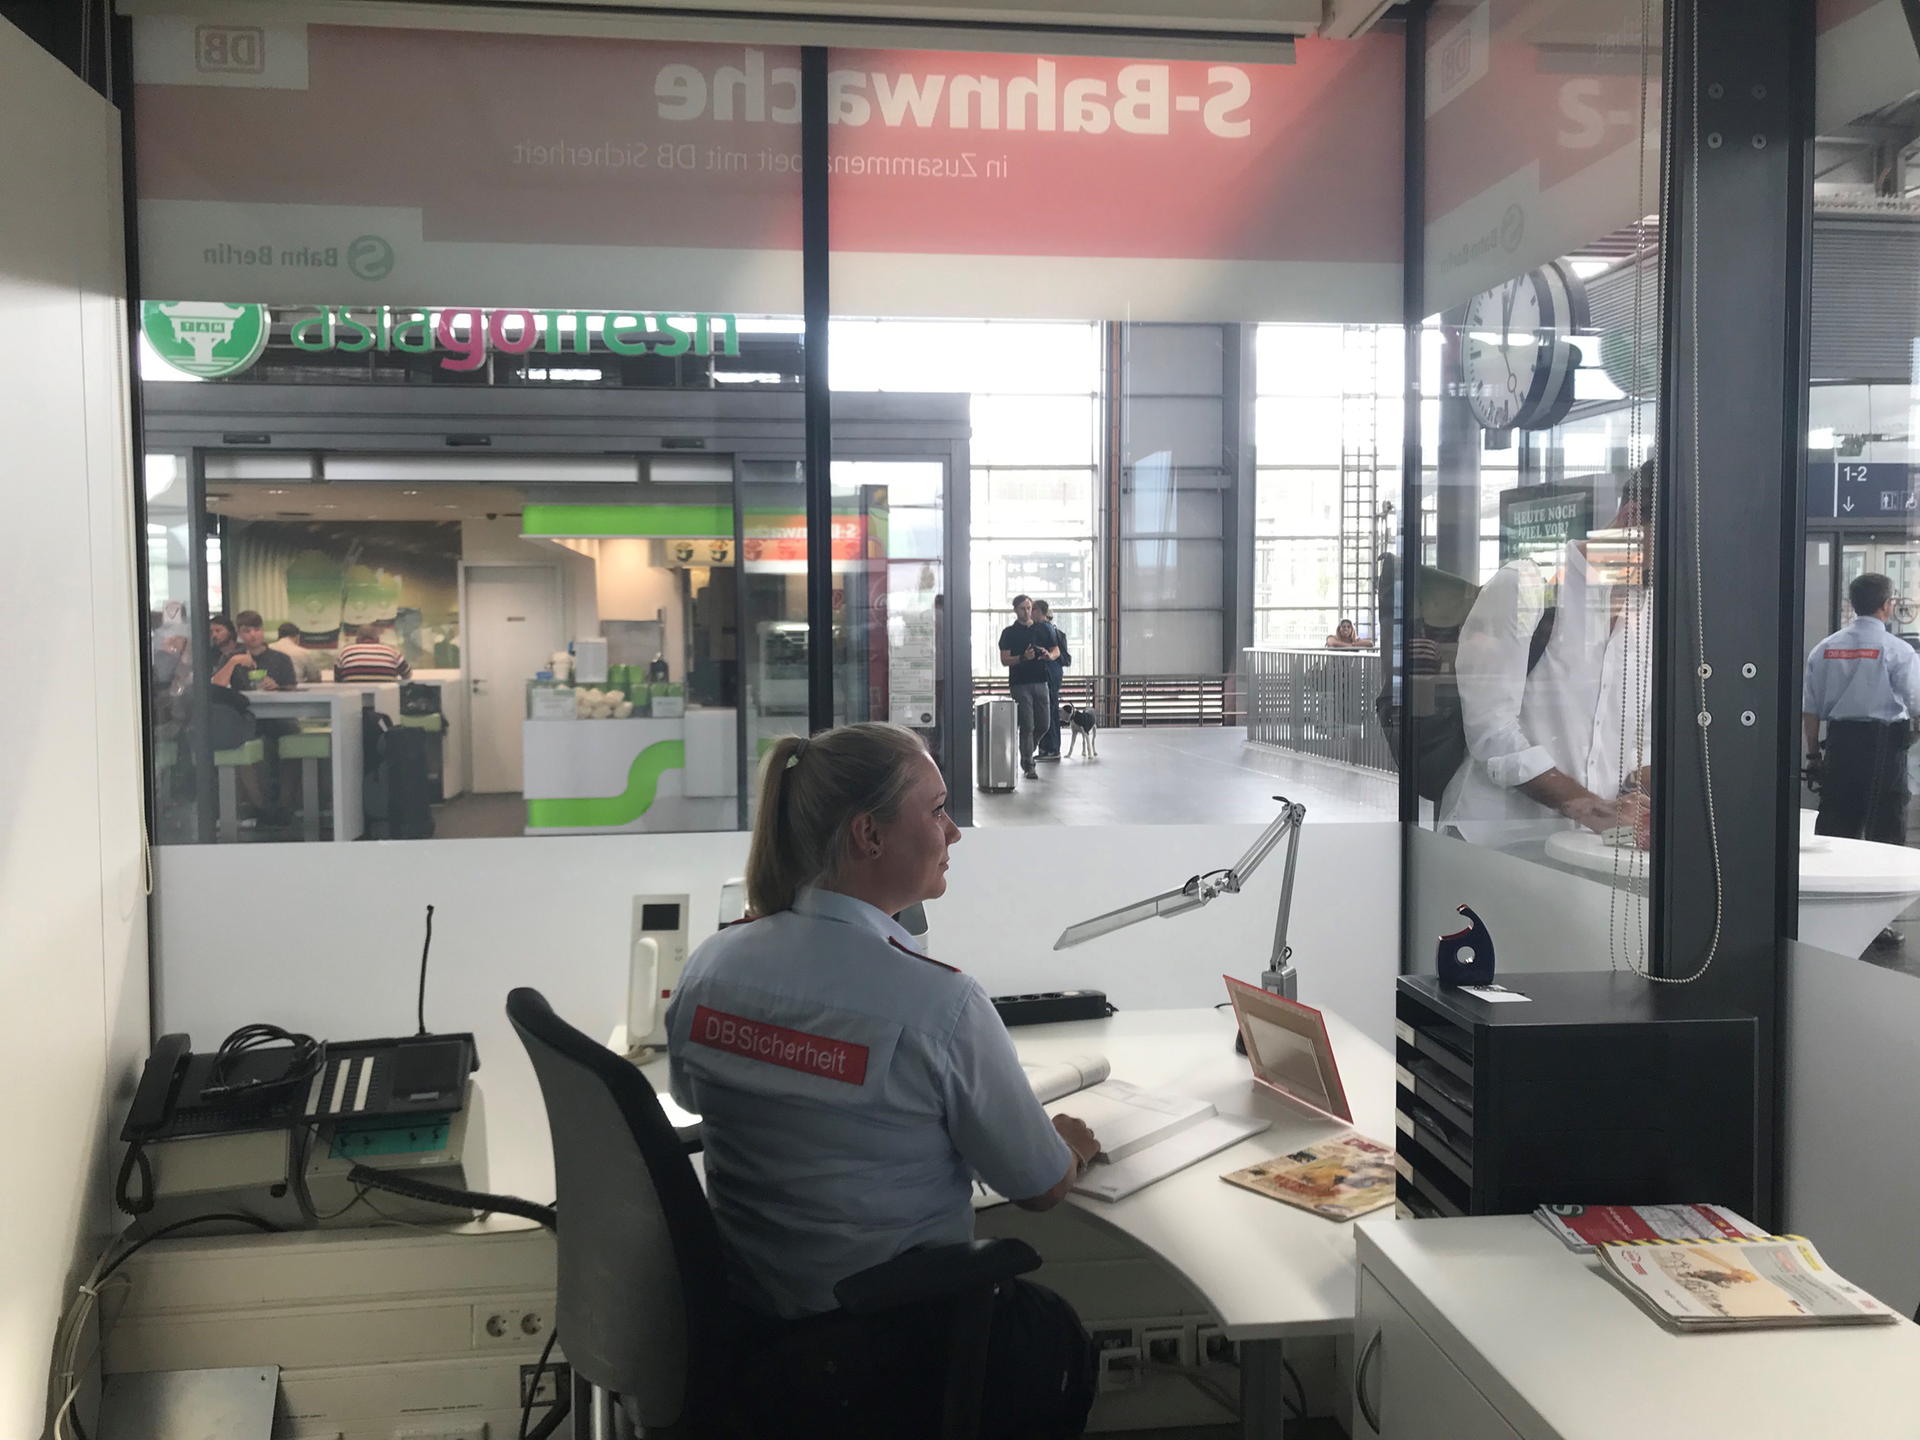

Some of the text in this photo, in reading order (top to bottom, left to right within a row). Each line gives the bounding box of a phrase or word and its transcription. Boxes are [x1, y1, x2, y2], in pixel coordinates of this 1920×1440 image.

[1843, 466, 1867, 482] 1-2
[1513, 504, 1577, 525] HEUTE NOCH
